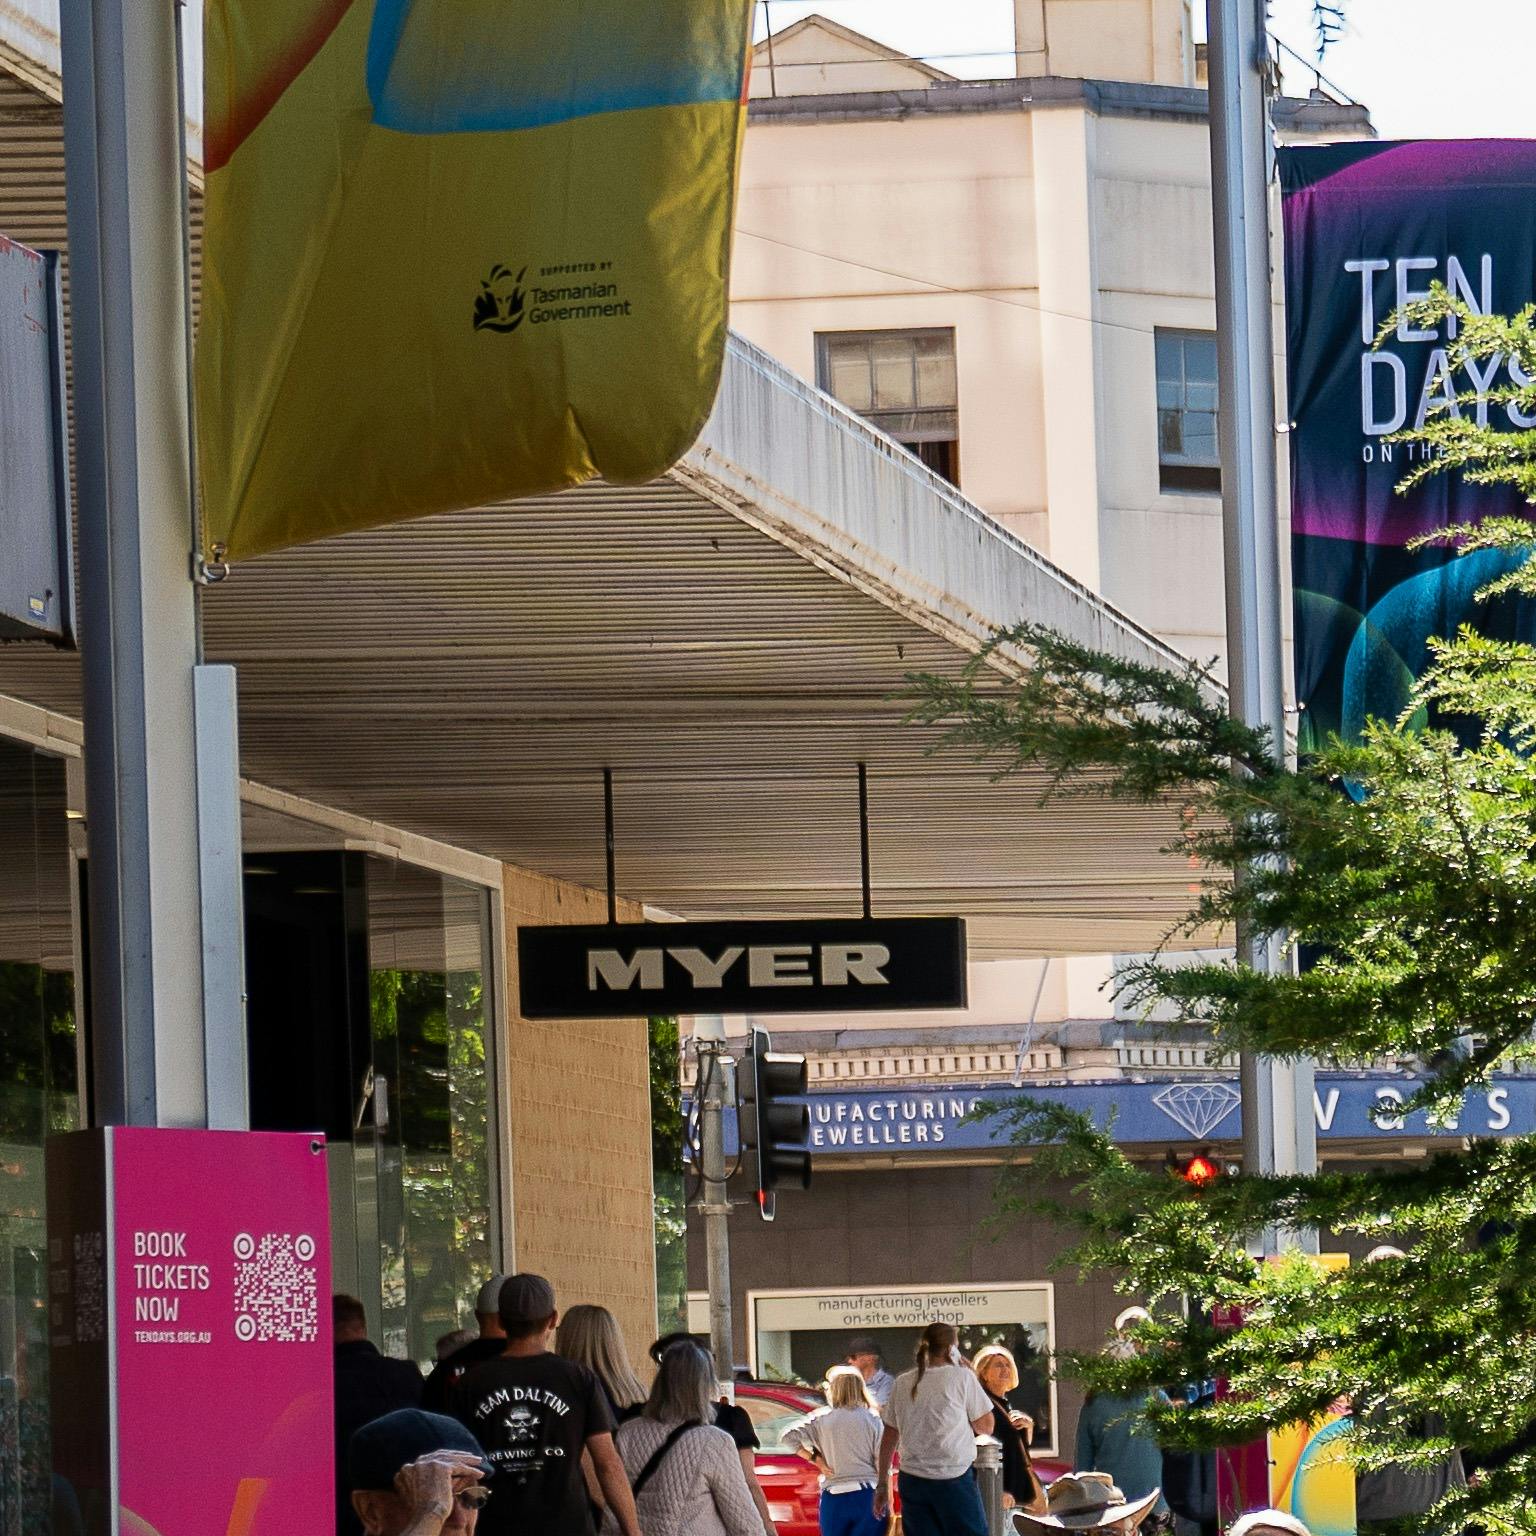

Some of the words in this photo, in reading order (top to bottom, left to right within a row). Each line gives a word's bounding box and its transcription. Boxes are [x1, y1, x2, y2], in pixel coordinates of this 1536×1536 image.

[540, 263, 597, 277] SUPPORTED
[600, 261, 613, 272] BY
[531, 282, 618, 304] Tasmanian
[1344, 254, 1493, 345] TEN
[529, 300, 633, 324] Government
[1362, 443, 1392, 463] ON
[588, 944, 891, 991] MYER
[134, 1232, 187, 1258] BOOK
[134, 1264, 210, 1290] TICKETS
[135, 1297, 179, 1322] NOW
[818, 1295, 922, 1311] manufacturing
[926, 1292, 988, 1309] jewellers
[843, 1311, 890, 1325] on-site
[893, 1309, 965, 1325] workshop
[135, 1331, 211, 1343] TENDAYS.ORG.AU
[475, 1388, 511, 1420] TEAM
[513, 1386, 570, 1416] DALTINI
[485, 1448, 536, 1461] REWING
[544, 1446, 566, 1457] CO.
